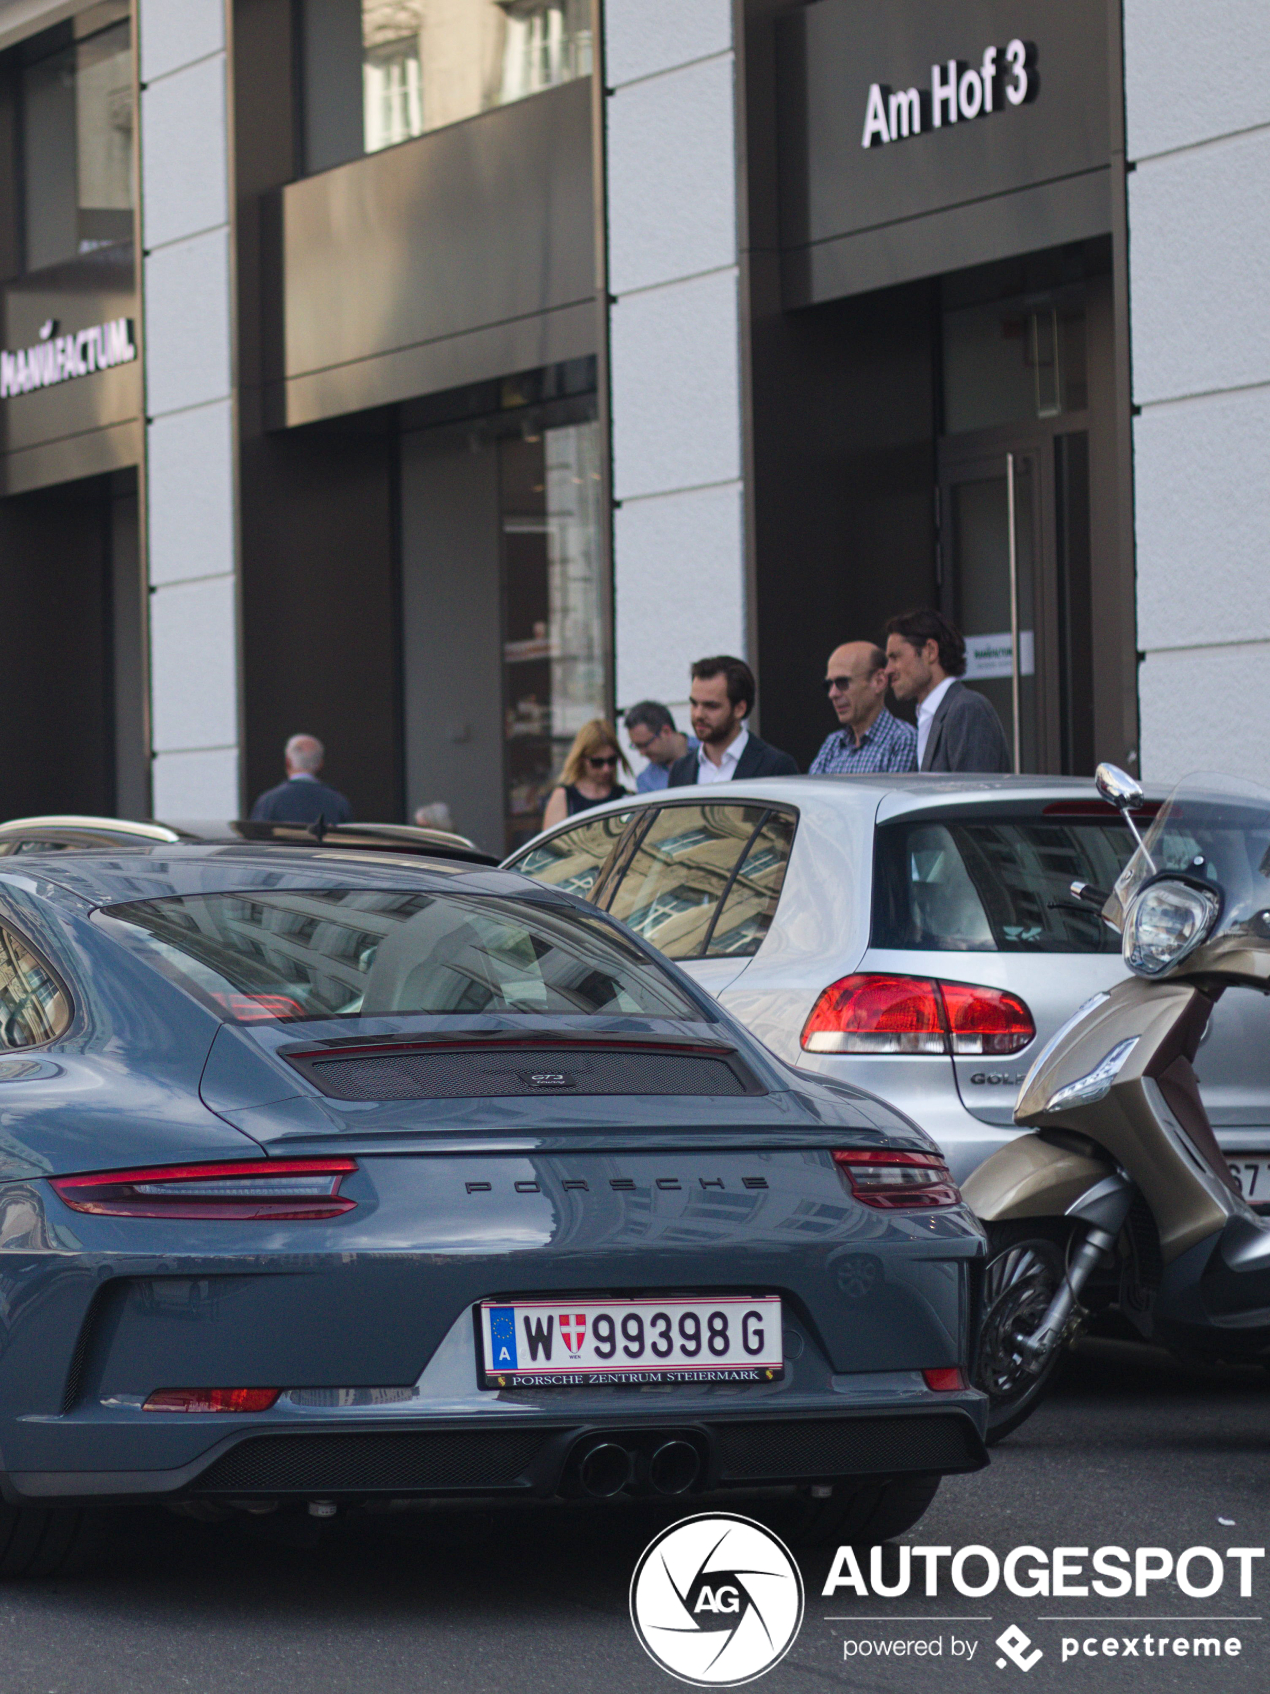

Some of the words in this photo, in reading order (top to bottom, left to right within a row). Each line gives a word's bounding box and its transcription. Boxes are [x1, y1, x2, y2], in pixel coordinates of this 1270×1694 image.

[861, 83, 921, 149] Am
[931, 46, 997, 128] Hof
[1005, 38, 1028, 106] 3
[465, 1176, 770, 1194] PORSCHE
[523, 1314, 554, 1362] W
[499, 1346, 511, 1361] A
[512, 1375, 584, 1386] PORSCHE
[589, 1373, 662, 1384] ZENTRUM
[667, 1370, 760, 1382] STEIERMARK
